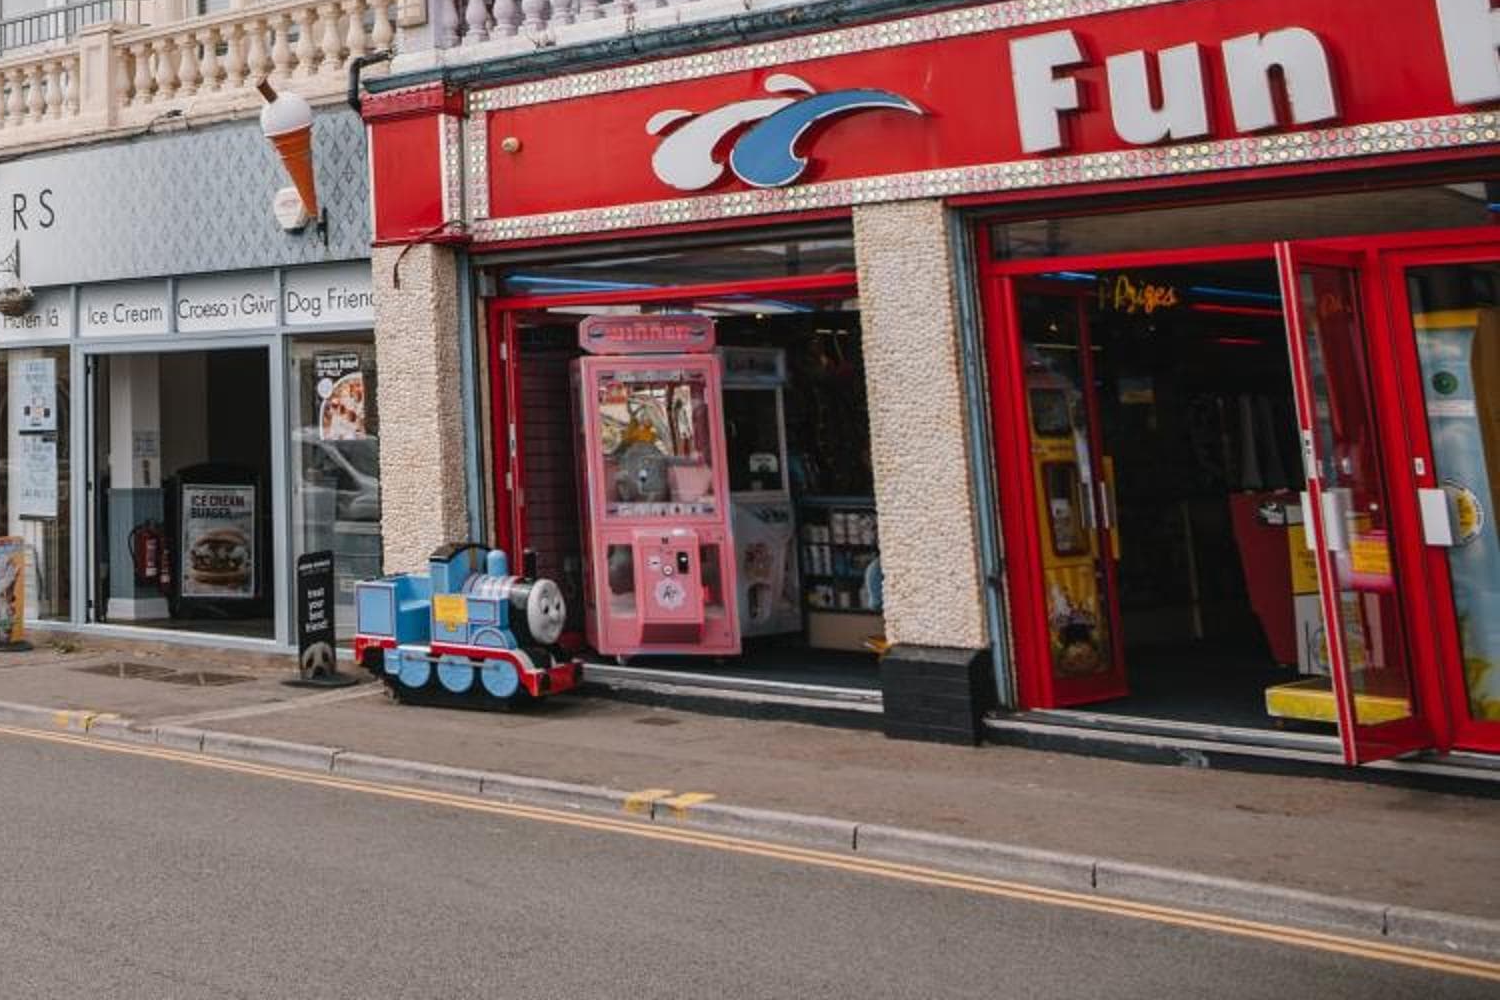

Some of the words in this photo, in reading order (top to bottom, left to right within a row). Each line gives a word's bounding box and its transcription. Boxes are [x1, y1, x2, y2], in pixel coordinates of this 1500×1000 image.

[1009, 27, 1340, 154] Fun
[286, 290, 322, 318] Dog
[1113, 274, 1177, 313] Prizes
[87, 303, 108, 325] Ice
[112, 302, 163, 323] Cream
[178, 299, 229, 320] Croeso
[231, 298, 238, 318] i
[191, 495, 208, 507] ICE
[209, 495, 245, 508] CREAM
[190, 508, 231, 519] BURGER
